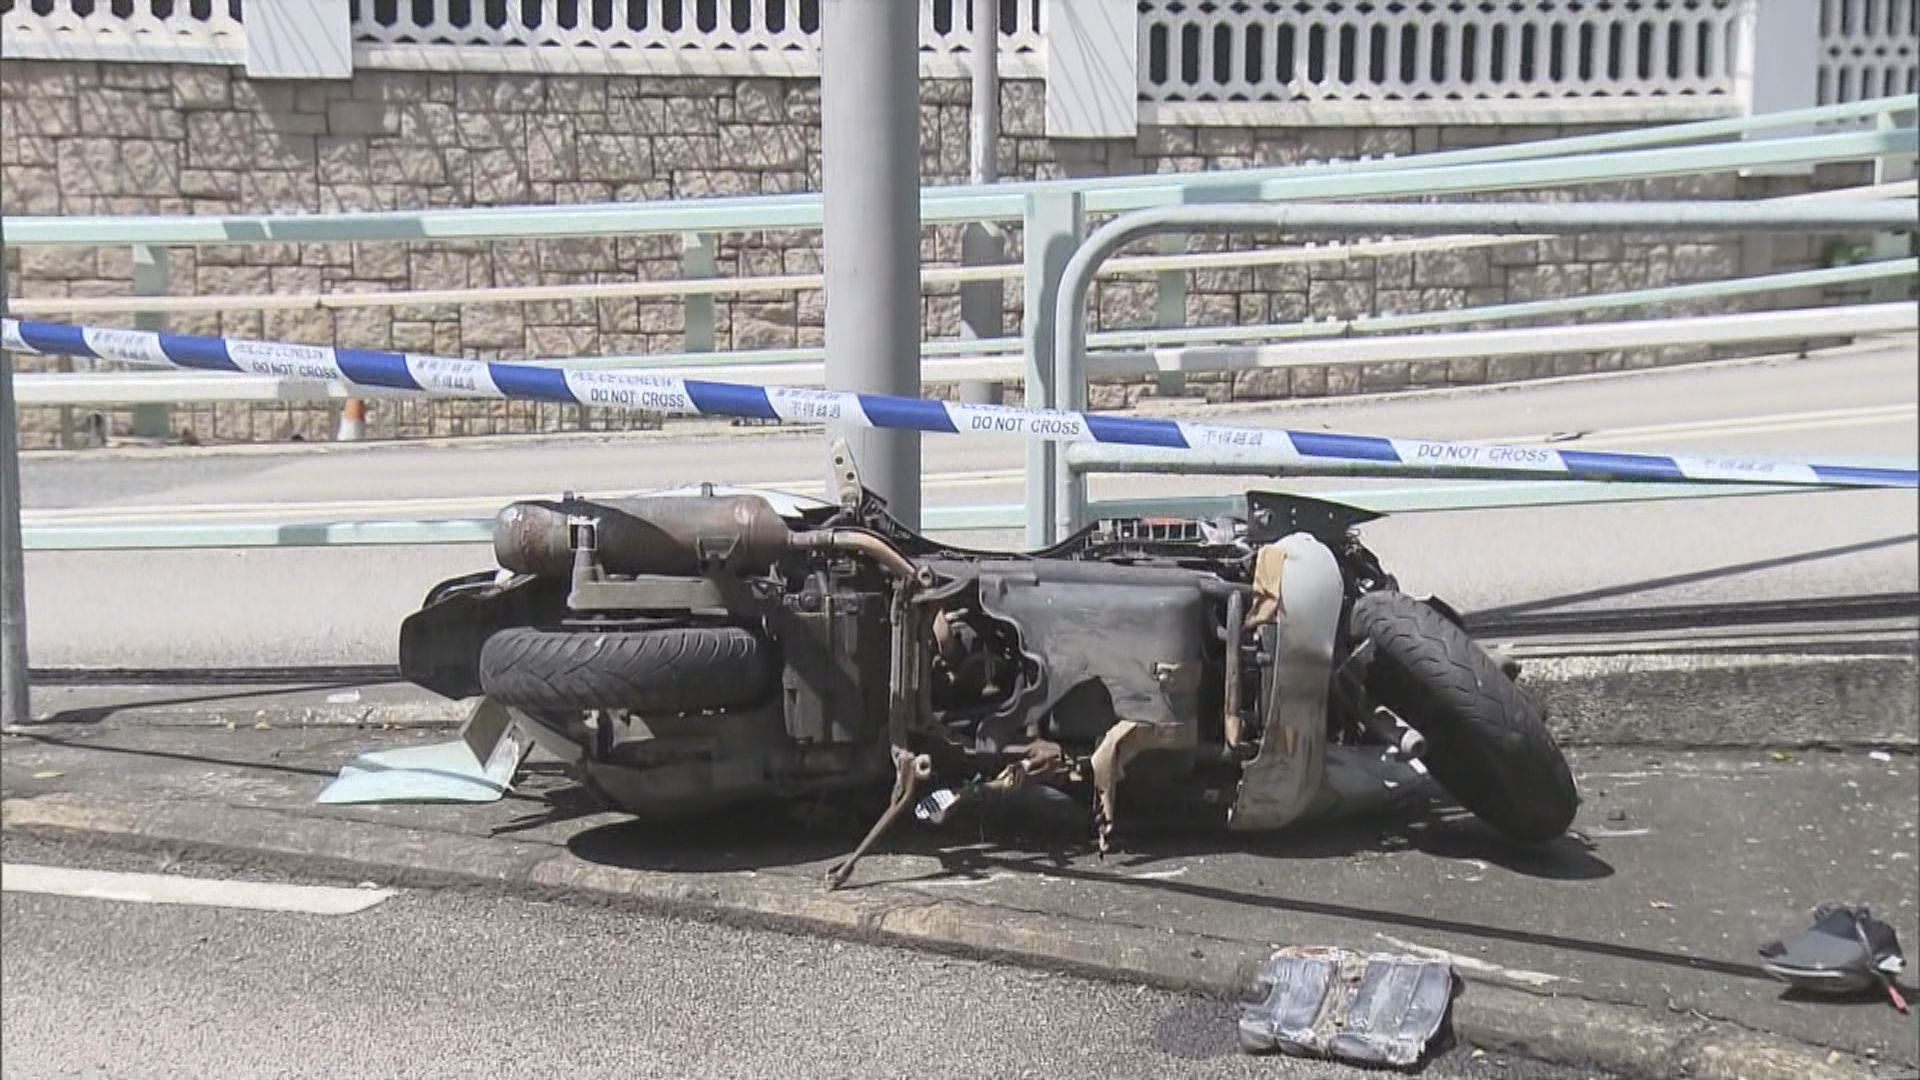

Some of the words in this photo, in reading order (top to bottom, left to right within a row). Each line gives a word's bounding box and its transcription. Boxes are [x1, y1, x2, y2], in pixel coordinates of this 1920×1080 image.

[252, 361, 269, 373] DO
[271, 363, 293, 376] NOT
[299, 365, 338, 379] CROSS
[591, 388, 608, 401] DO
[611, 389, 635, 405] NOT
[642, 392, 684, 407] CROSS
[971, 416, 992, 429] DO
[995, 417, 1024, 431] NOT
[1030, 419, 1080, 435] CROSS
[1417, 443, 1442, 457] DO
[1445, 445, 1480, 459] NOT
[1488, 447, 1548, 462] CROSS
